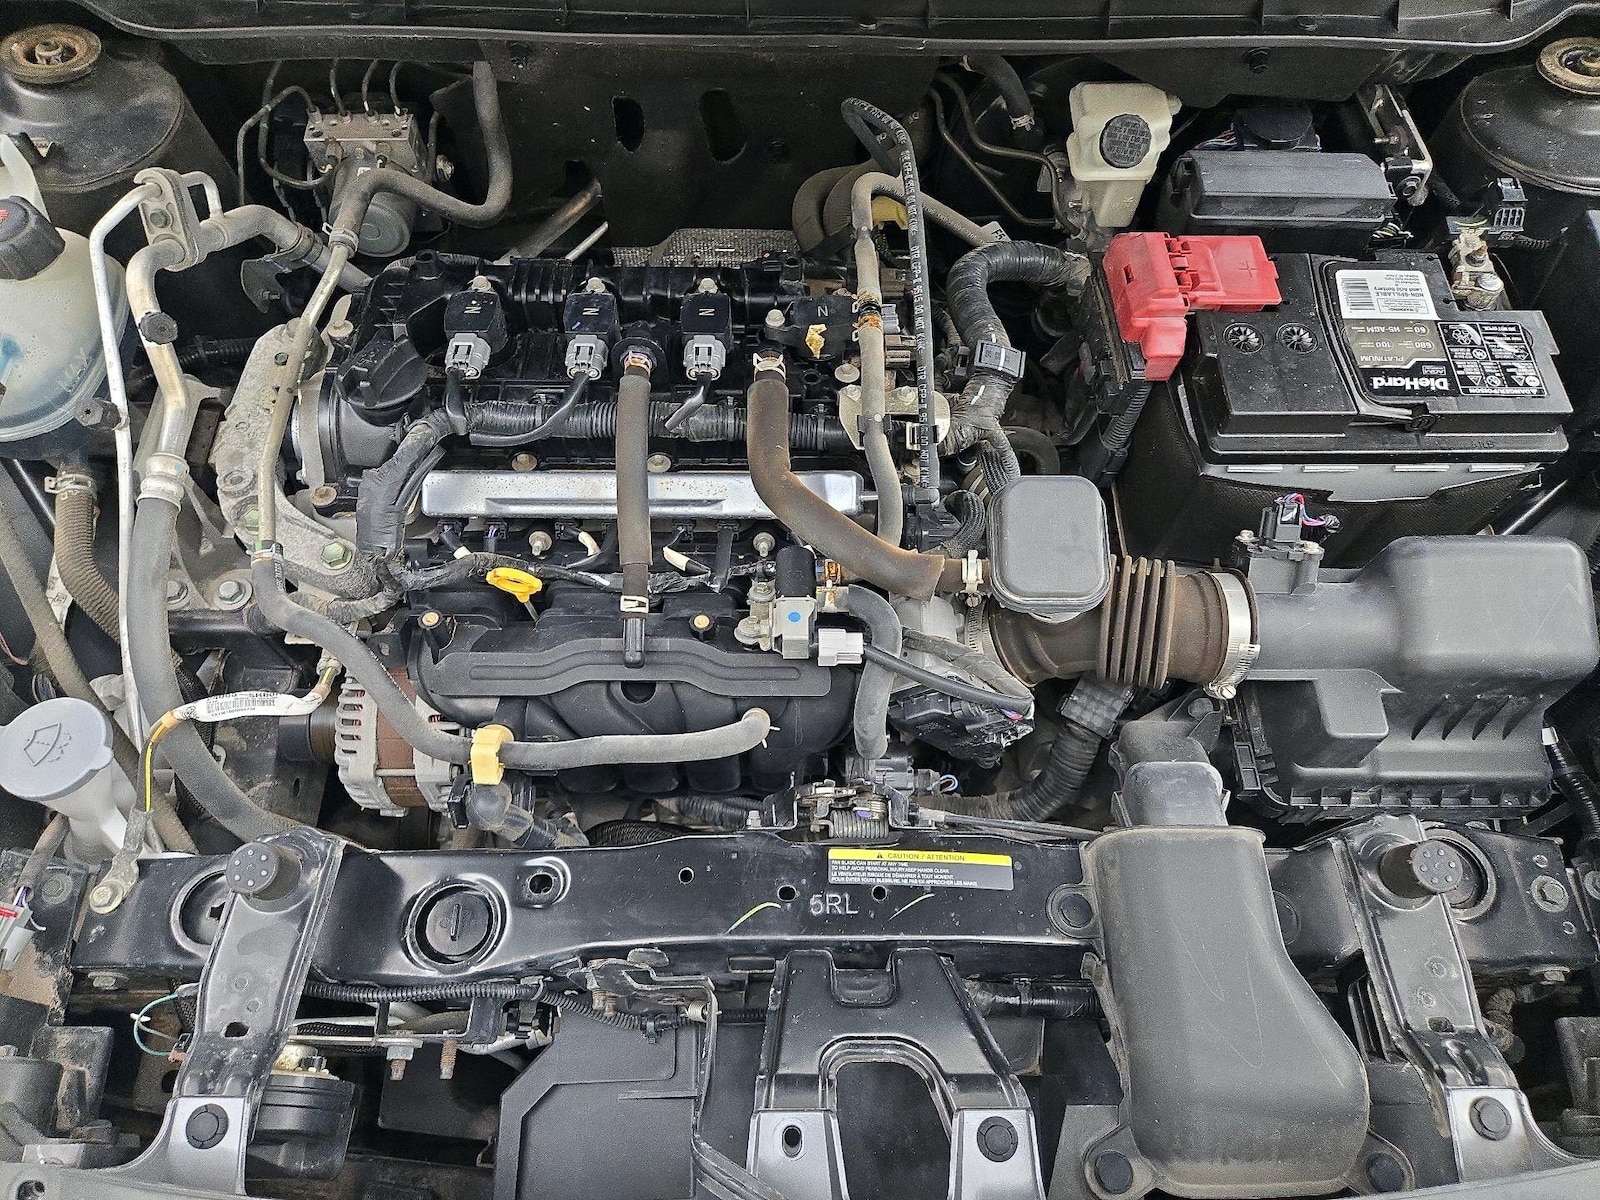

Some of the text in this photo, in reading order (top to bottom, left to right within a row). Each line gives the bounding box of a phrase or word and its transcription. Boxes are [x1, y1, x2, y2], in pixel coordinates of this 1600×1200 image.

[991, 228, 1006, 240] F5
[915, 316, 926, 330] NOT
[1366, 325, 1401, 333] H5-AGM
[1415, 341, 1432, 349] 680
[1371, 377, 1449, 391] DieHard
[919, 449, 929, 463] NOT
[887, 852, 919, 860] CAUTION
[809, 893, 859, 917] 5RL
